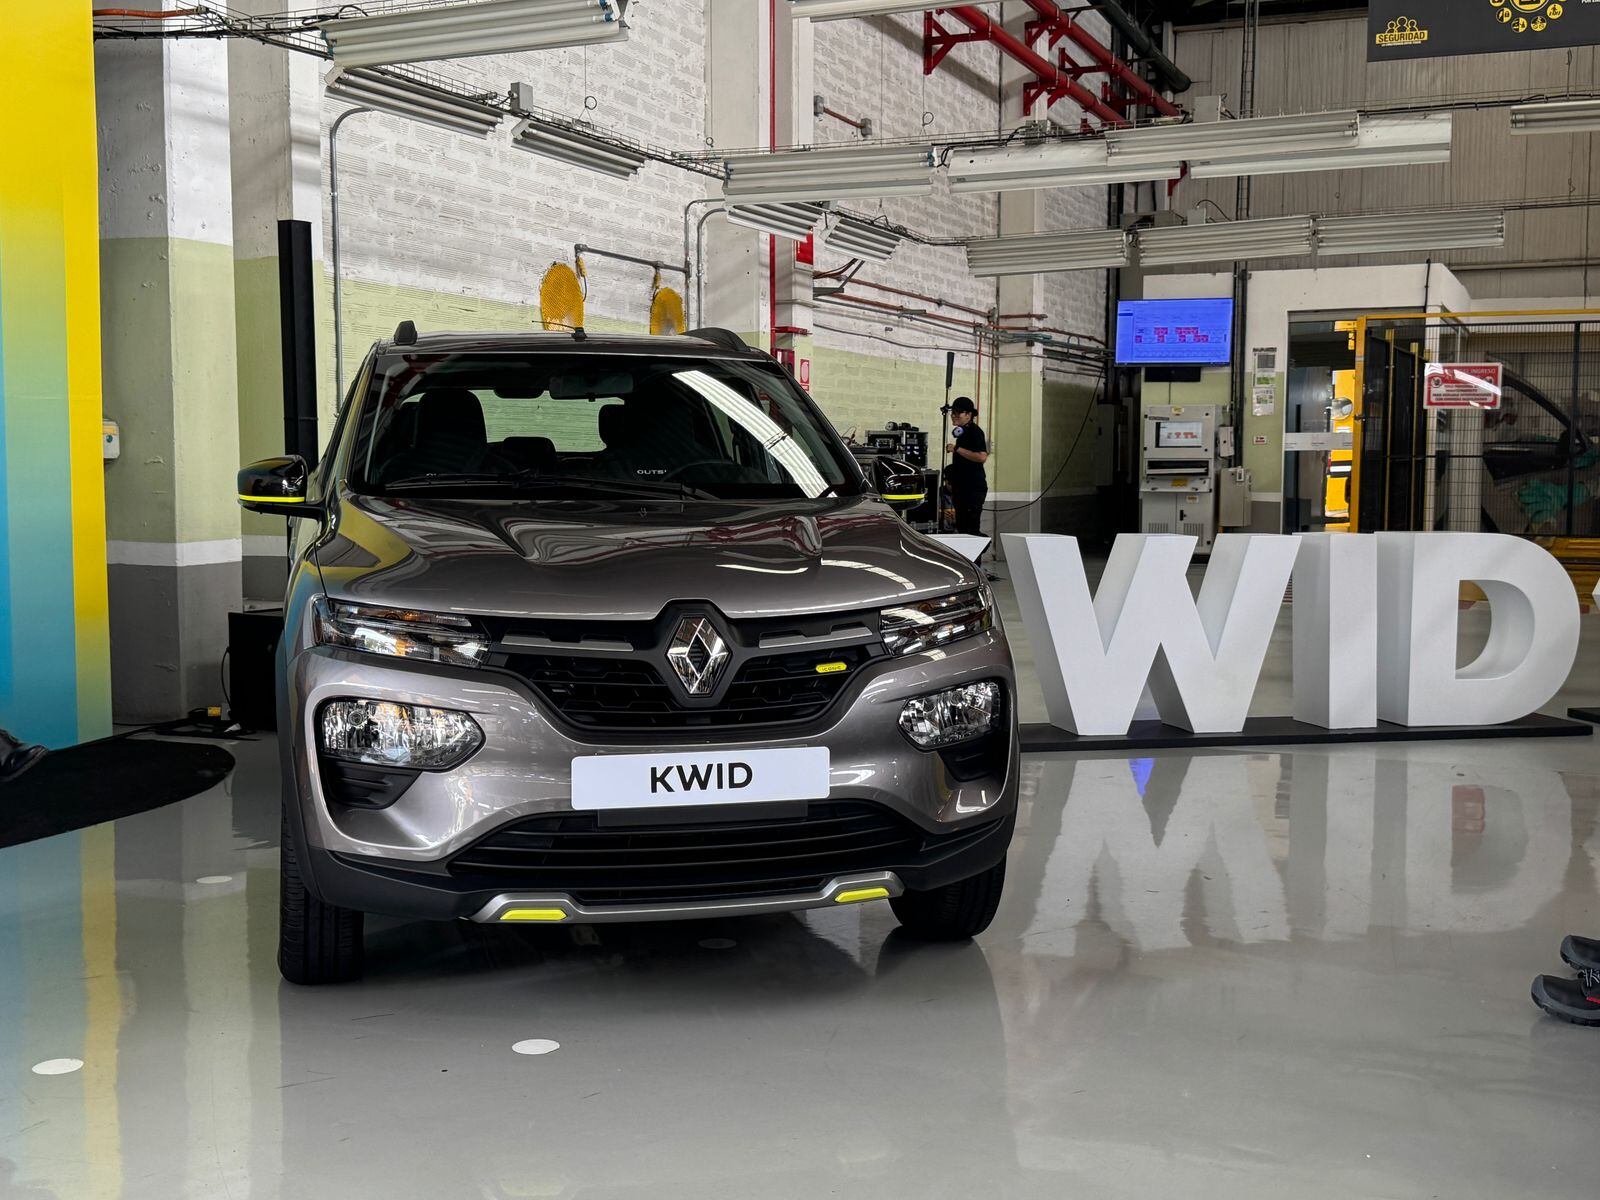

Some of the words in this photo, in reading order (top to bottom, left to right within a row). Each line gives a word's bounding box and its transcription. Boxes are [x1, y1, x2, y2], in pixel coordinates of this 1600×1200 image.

[1379, 32, 1425, 42] SEGURIDAD
[935, 531, 1582, 735] WID
[650, 762, 753, 793] KWID
